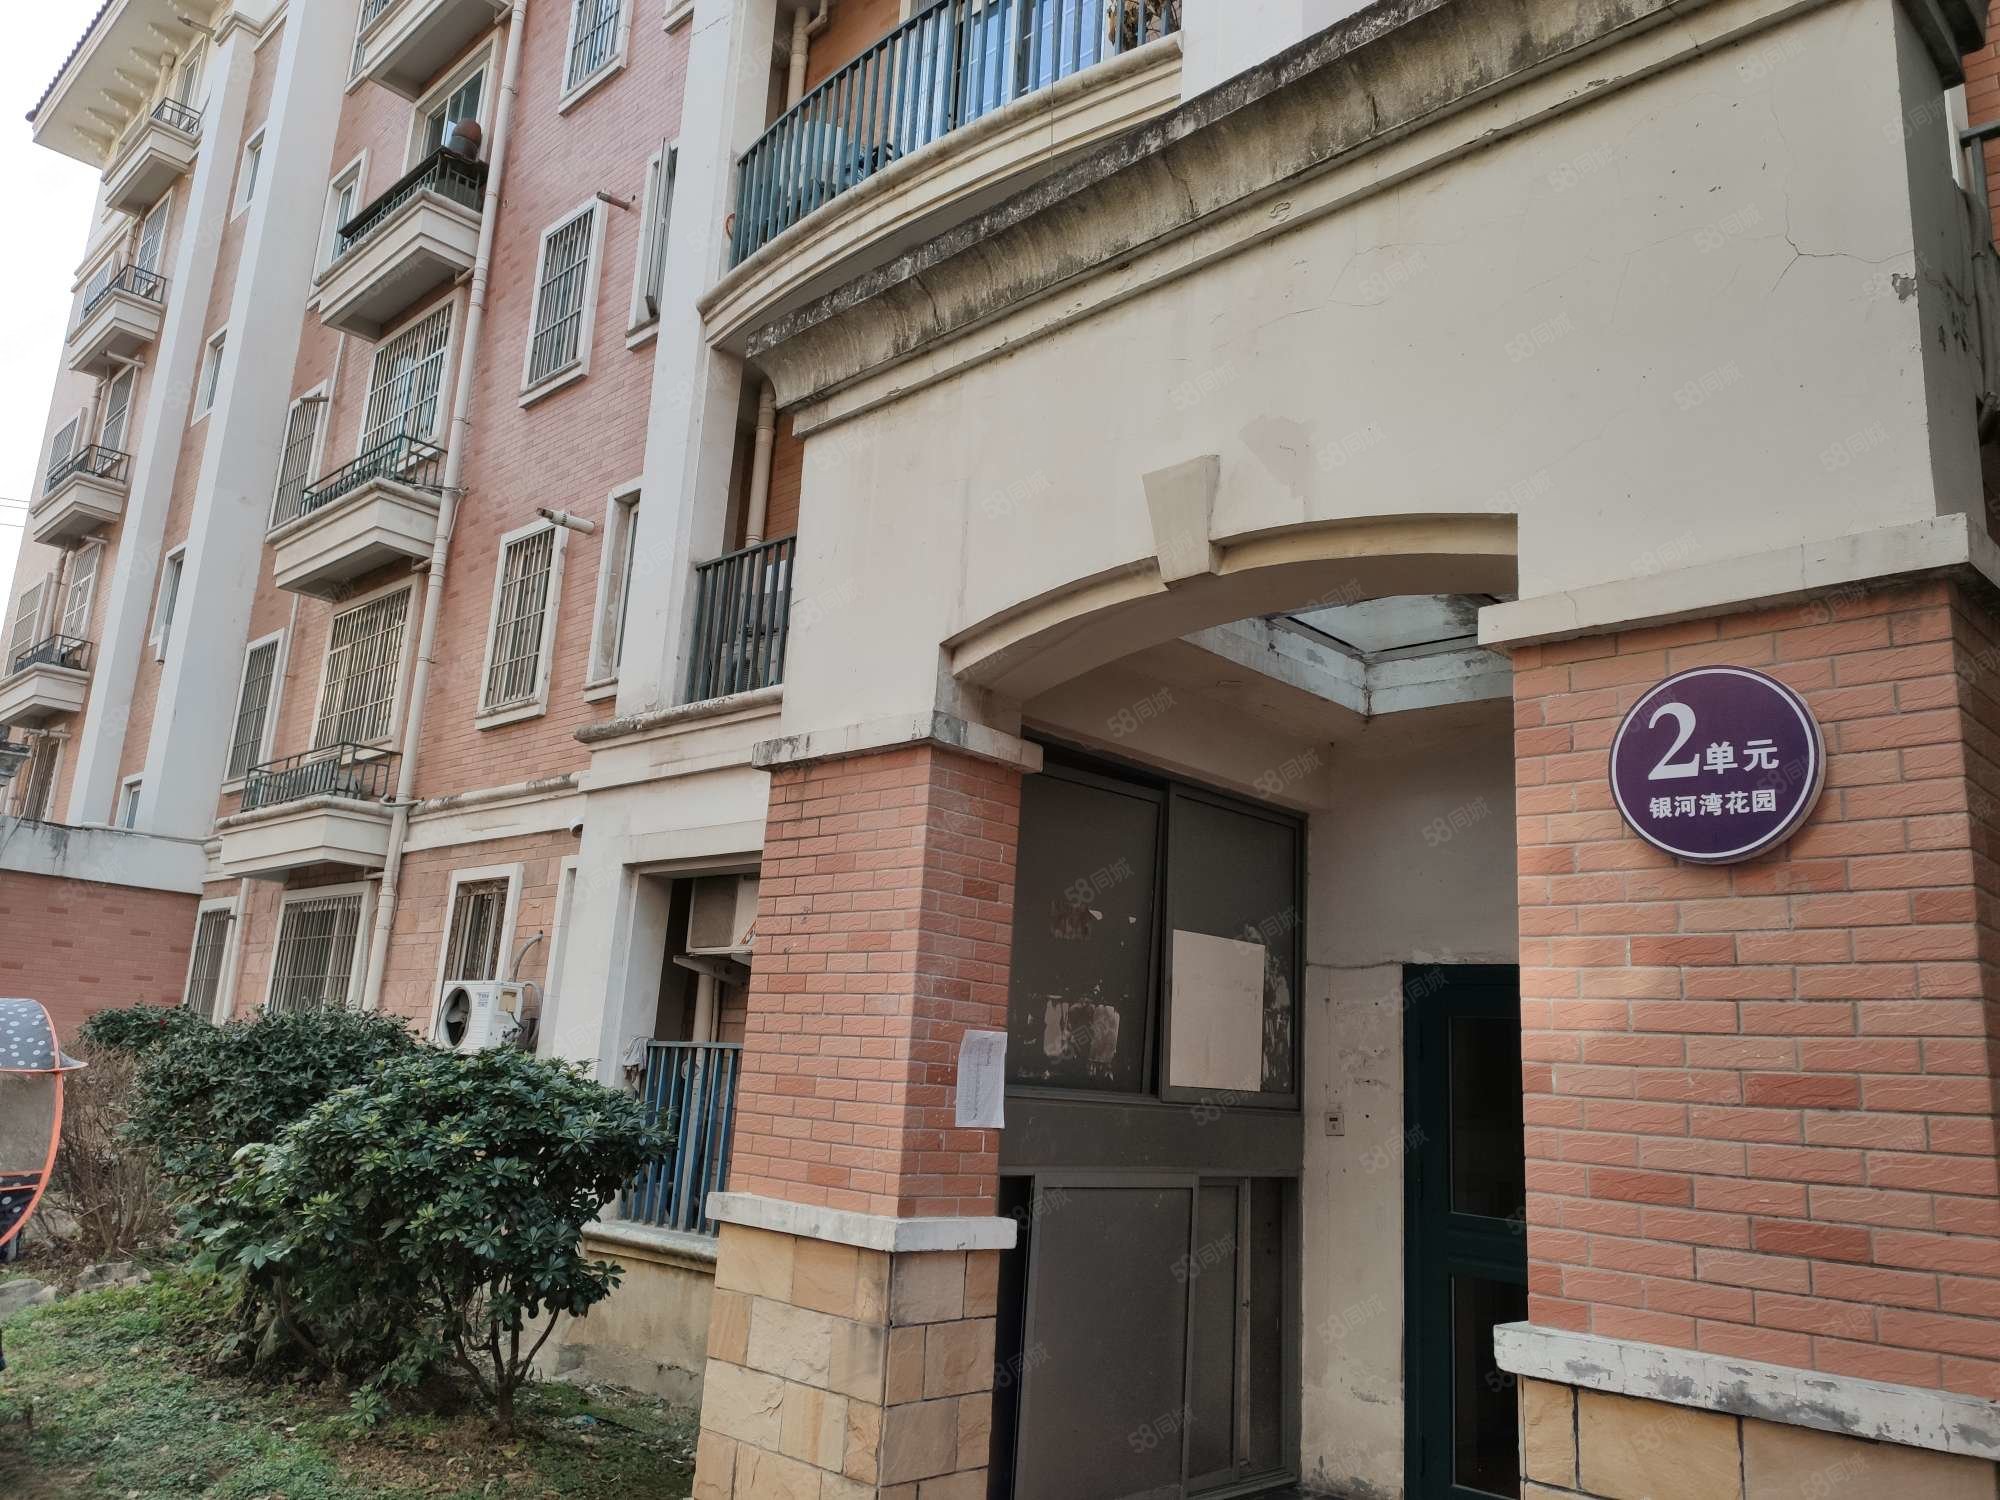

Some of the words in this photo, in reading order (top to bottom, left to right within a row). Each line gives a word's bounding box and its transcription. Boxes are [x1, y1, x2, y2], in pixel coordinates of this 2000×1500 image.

[1647, 702, 1780, 781] 2单元
[1649, 788, 1777, 819] 银河湾花园
